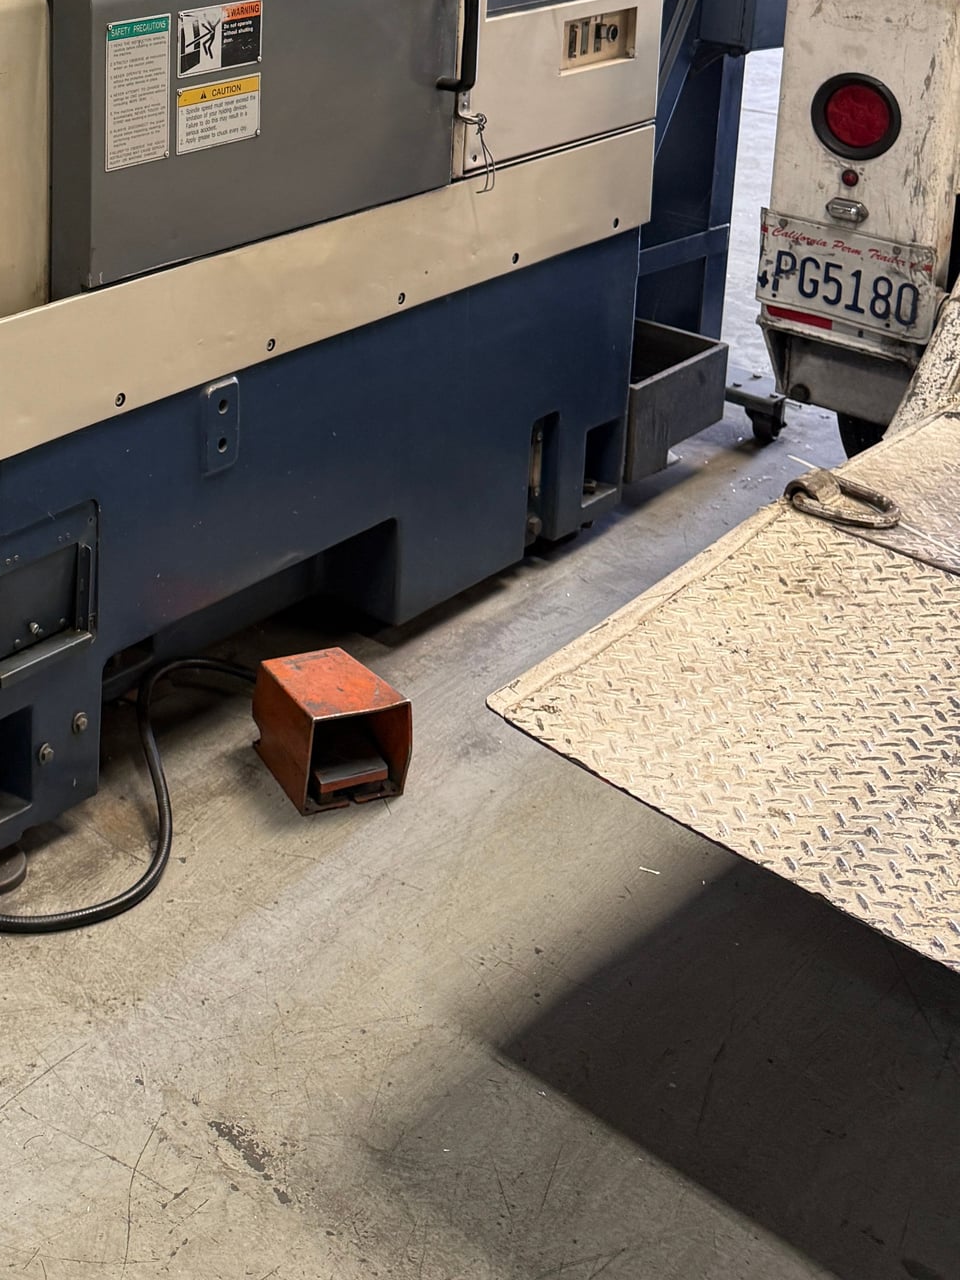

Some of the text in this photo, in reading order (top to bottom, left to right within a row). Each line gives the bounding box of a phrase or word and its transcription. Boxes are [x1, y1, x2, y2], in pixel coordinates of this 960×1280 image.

[230, 3, 259, 17] WARNING
[111, 20, 166, 37] SAFETY PRECAUTIONS
[211, 83, 241, 96] CAUTION
[772, 226, 828, 248] California
[833, 240, 862, 255] Perm
